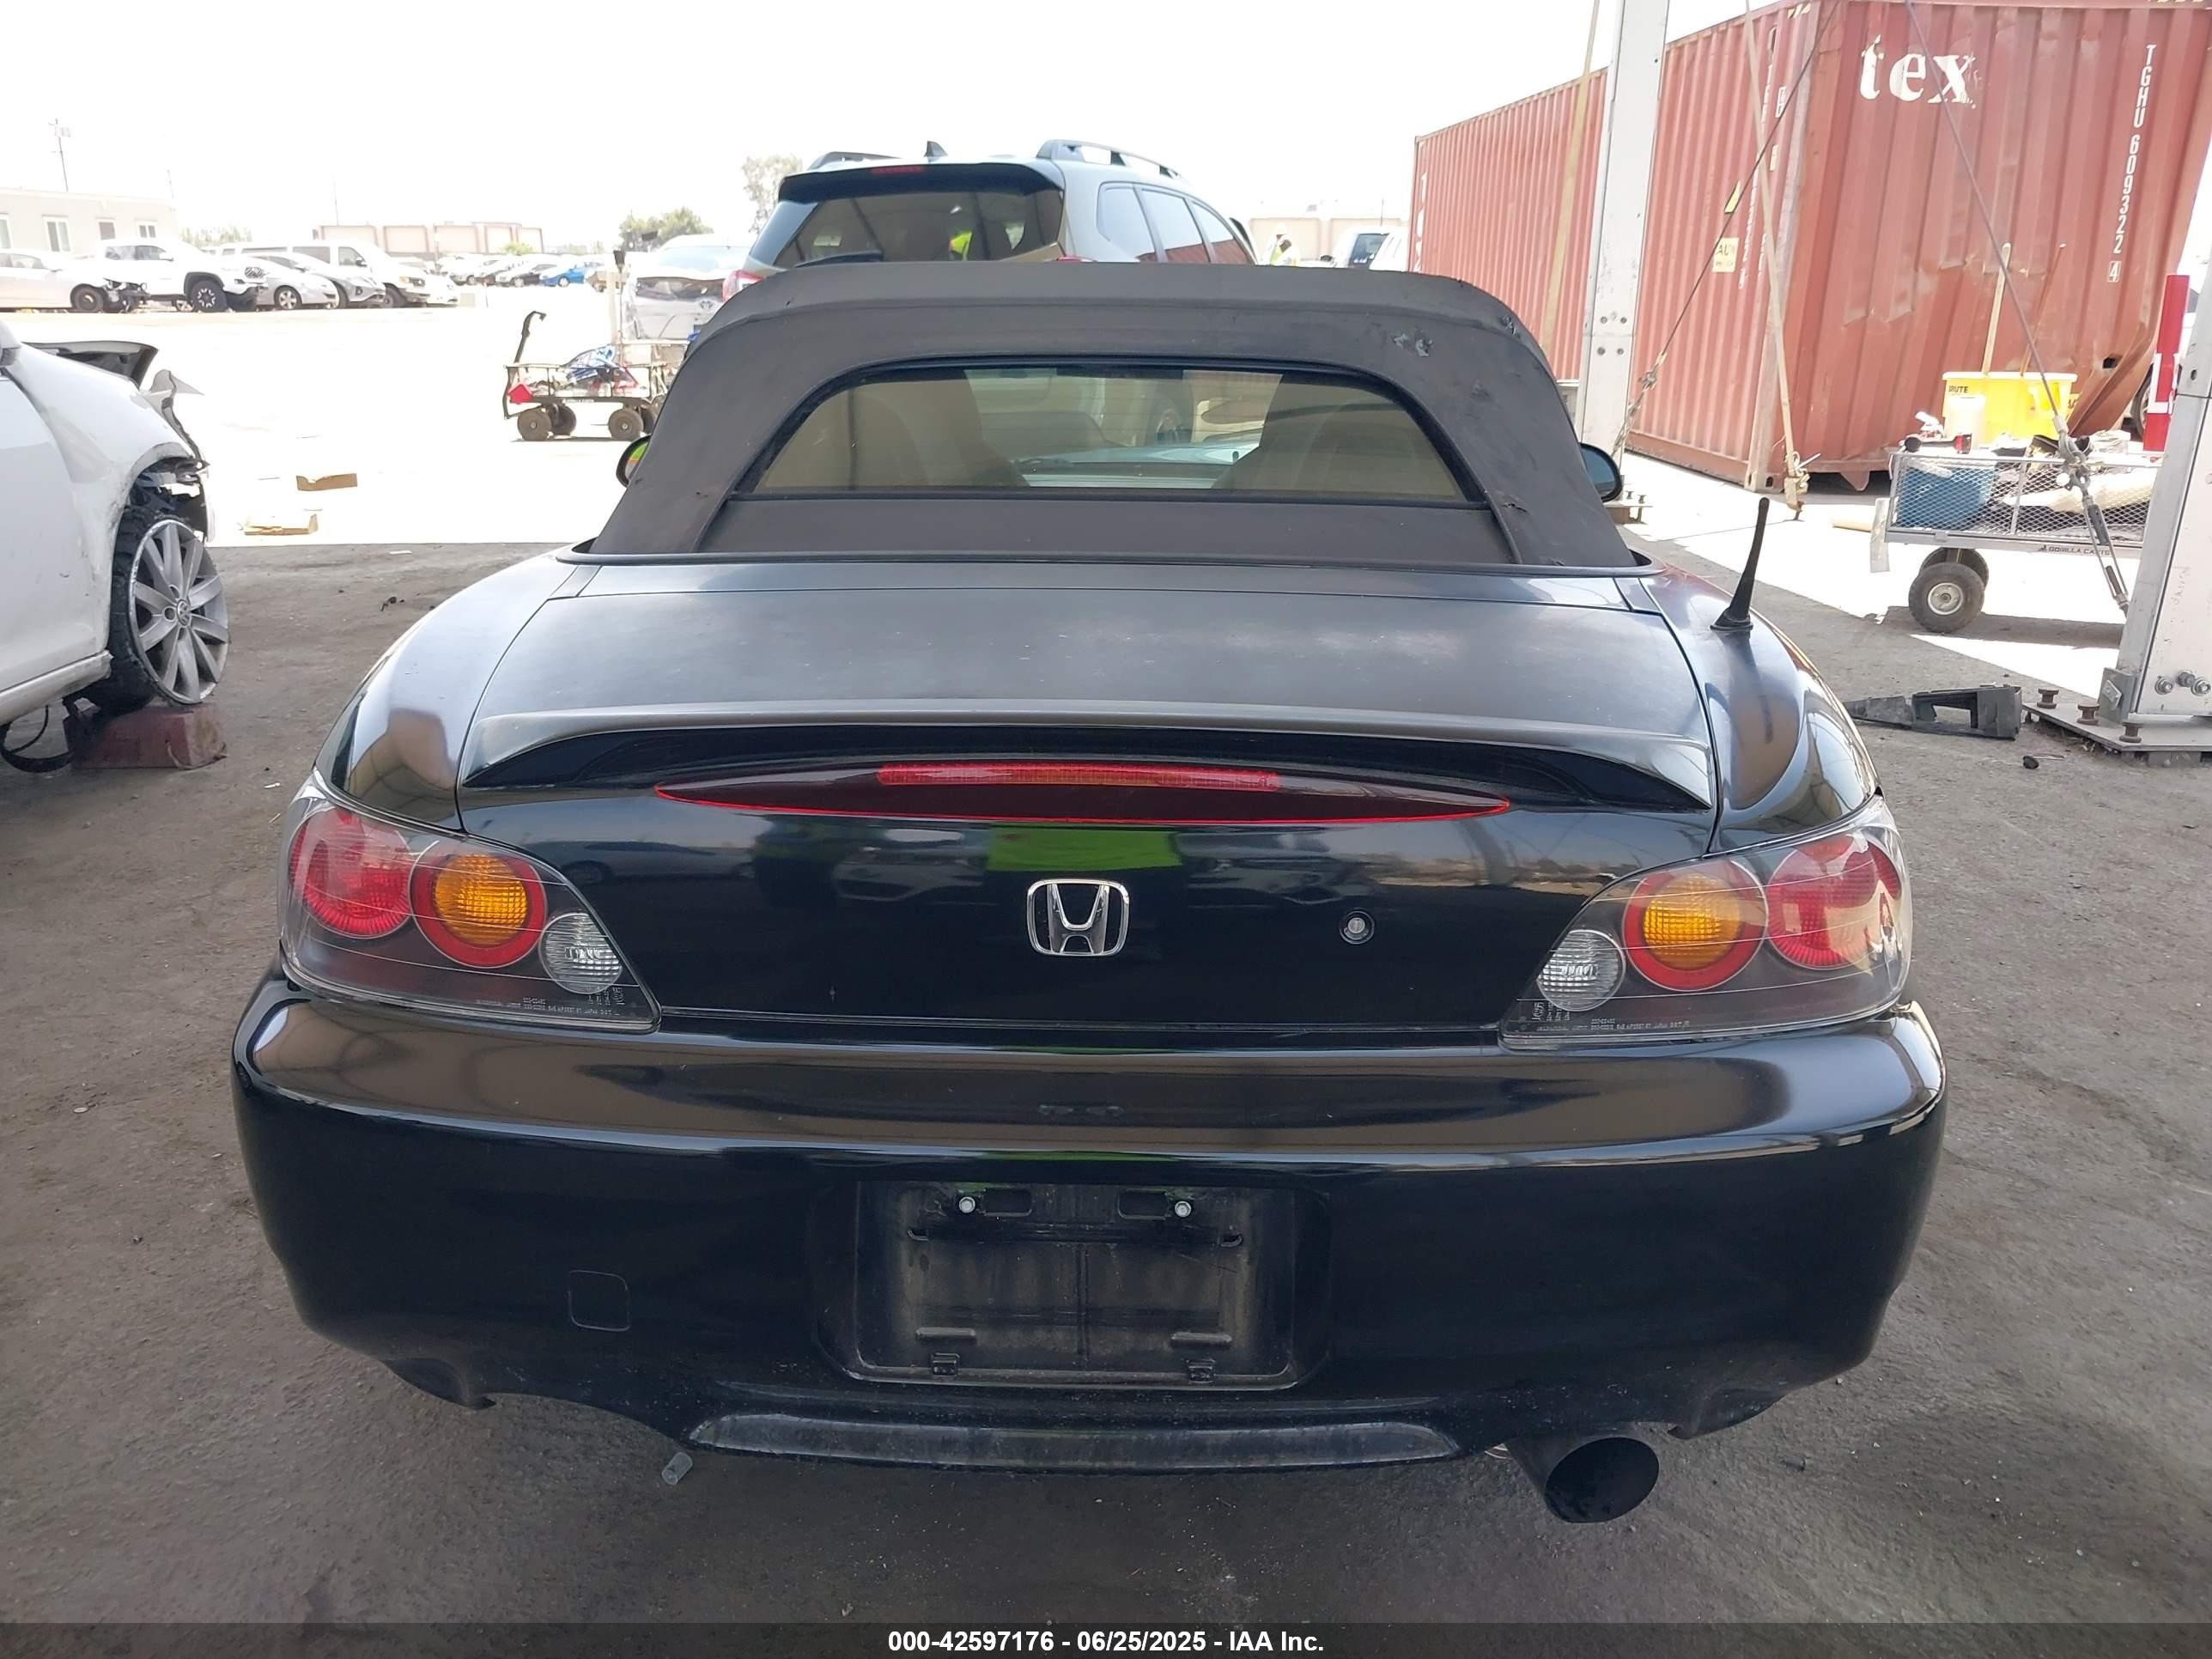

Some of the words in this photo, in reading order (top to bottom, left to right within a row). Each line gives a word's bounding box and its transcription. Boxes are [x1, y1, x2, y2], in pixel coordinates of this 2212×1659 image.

[1860, 33, 1976, 104] tex
[2133, 44, 2157, 128] TGHU
[2113, 134, 2141, 253] 609322
[2108, 261, 2121, 283] 4
